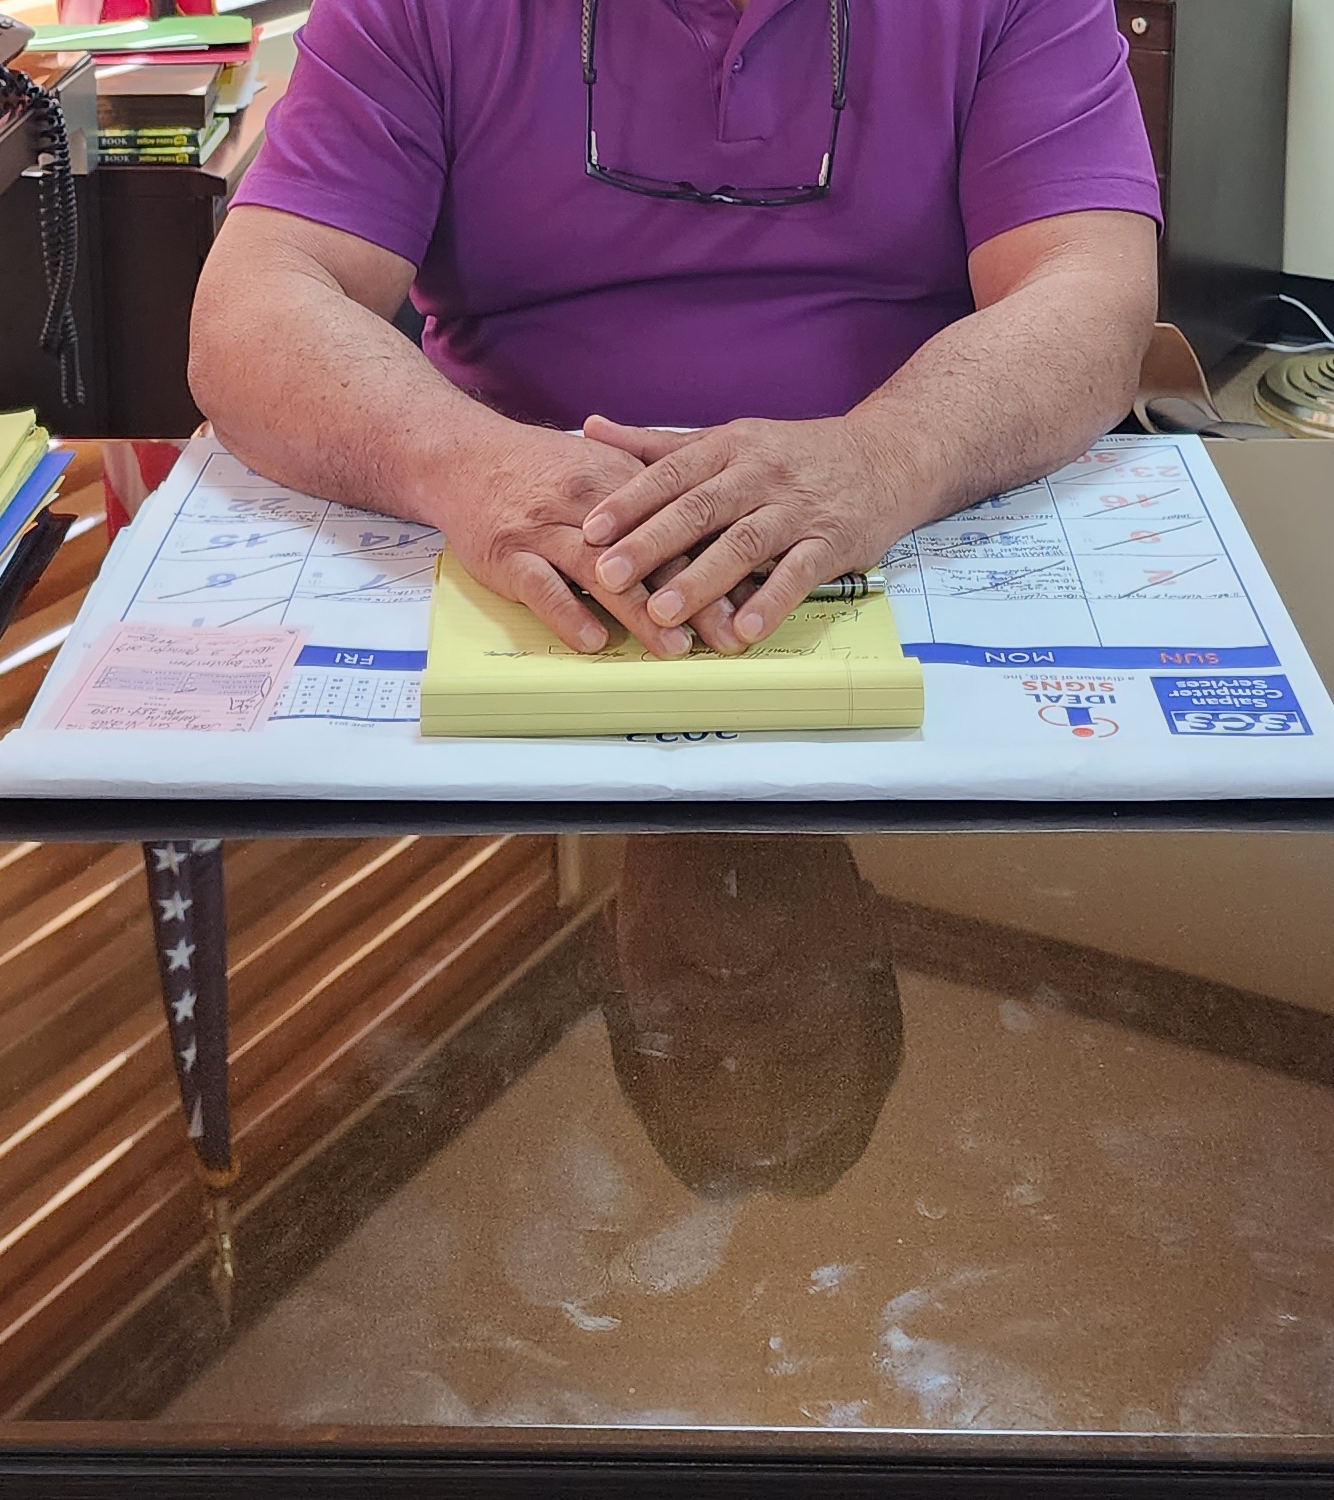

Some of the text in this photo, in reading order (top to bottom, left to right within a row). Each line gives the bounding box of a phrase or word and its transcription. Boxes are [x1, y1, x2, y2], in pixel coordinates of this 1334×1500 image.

[1130, 465, 1181, 478] 23
[228, 498, 290, 512] 22
[1099, 495, 1159, 508] 16
[209, 533, 267, 548] 15
[359, 532, 417, 549] 14
[207, 573, 236, 589] 8
[359, 574, 387, 589] 7
[1143, 570, 1177, 586] 2
[334, 651, 1220, 665] SUN MON FRI
[1022, 681, 1115, 692] SIGNS
[1175, 679, 1267, 689] Services
[1025, 693, 1116, 704] IDEAL
[1169, 687, 1283, 699] Computer
[1191, 695, 1268, 708] Saipan
[1184, 712, 1292, 732] SCS
